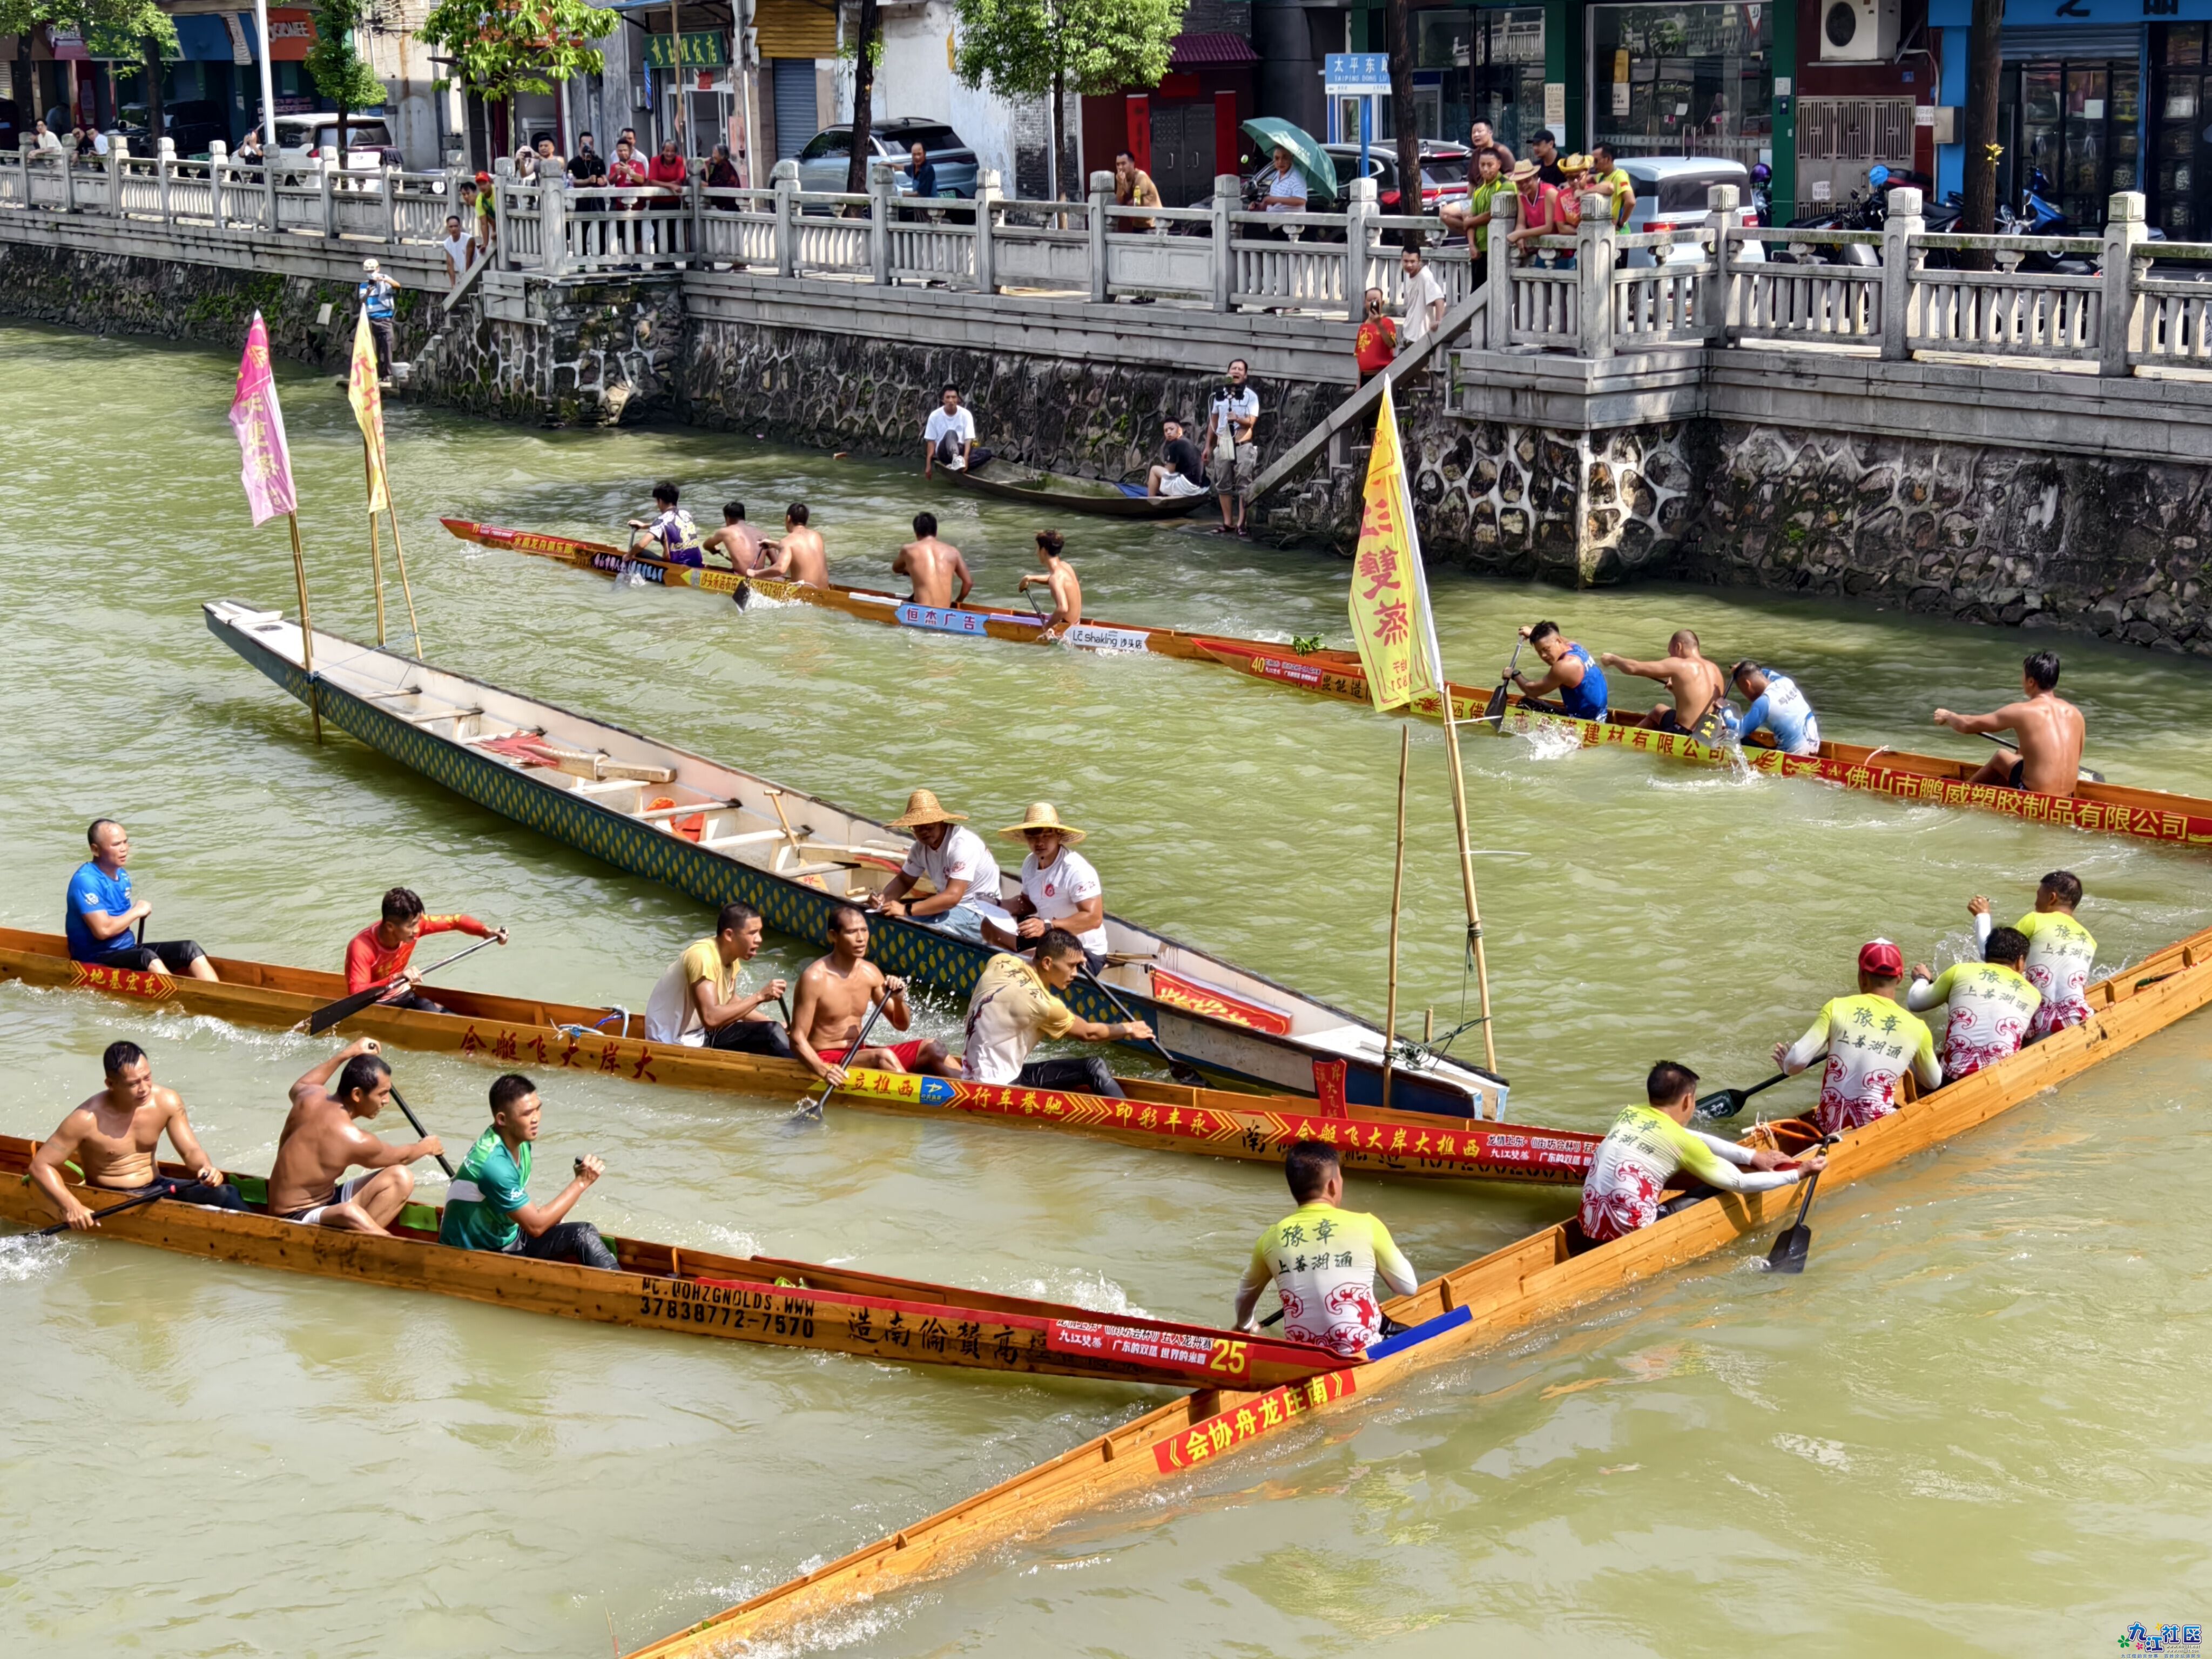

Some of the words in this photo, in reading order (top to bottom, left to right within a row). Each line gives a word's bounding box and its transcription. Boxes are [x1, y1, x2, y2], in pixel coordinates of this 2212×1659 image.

[907, 607, 975, 630] 恒杰广告
[1251, 656, 1265, 673] 40
[1845, 765, 2188, 840] 佛山市鹏威塑胶制品有限公司
[1281, 1218, 1339, 1247] 豫章
[1210, 1339, 1248, 1374] 25
